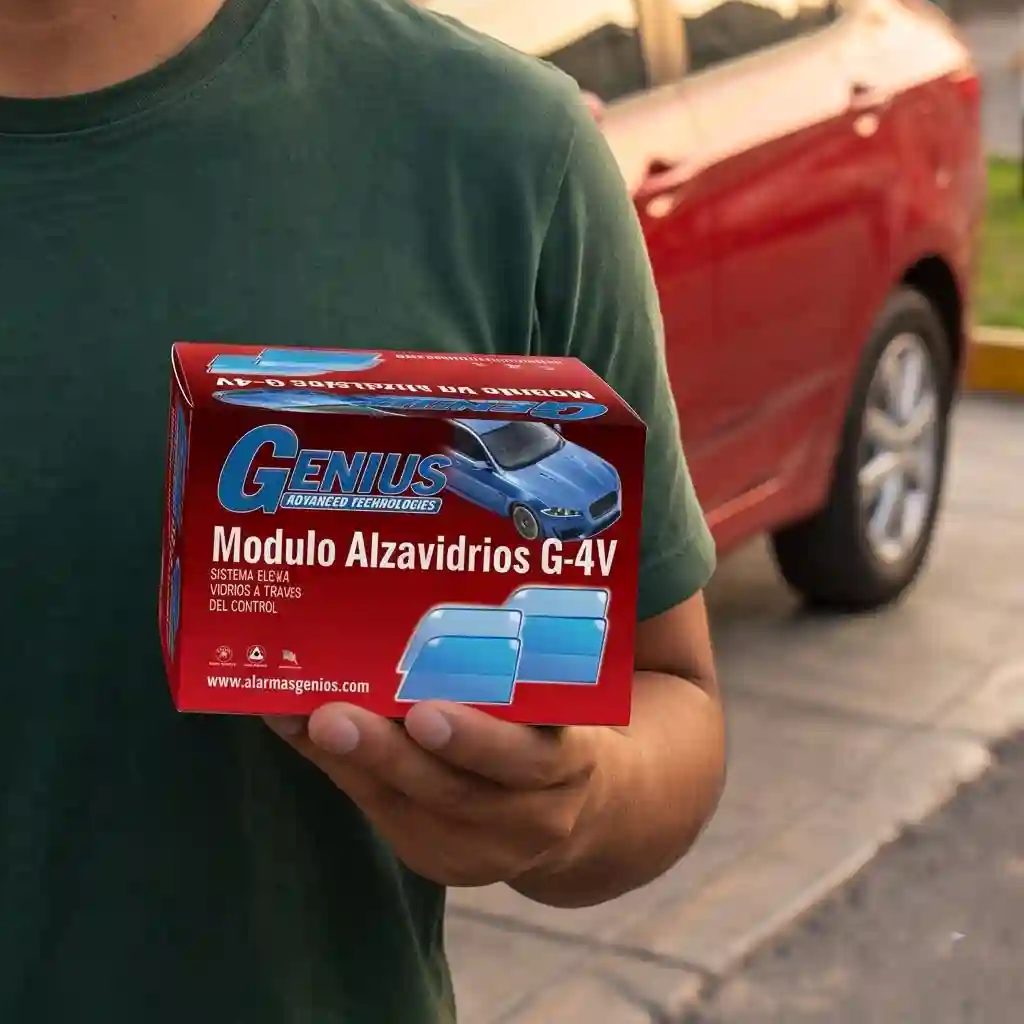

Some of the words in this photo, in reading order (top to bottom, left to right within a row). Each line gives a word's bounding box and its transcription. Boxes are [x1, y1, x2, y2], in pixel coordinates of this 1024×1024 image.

[217, 423, 453, 515] GENIUS
[212, 525, 336, 567] Modulo
[345, 531, 531, 574] Alzavidrios
[541, 537, 618, 577] G-4V
[210, 567, 254, 581] SISTEMA
[210, 583, 251, 597] VIDRIOS
[253, 584, 261, 597] A
[264, 584, 302, 599] TRAVES
[209, 598, 228, 612] DEL
[231, 599, 278, 614] CONTROL
[207, 674, 370, 695] www.alarmasgenios.com
